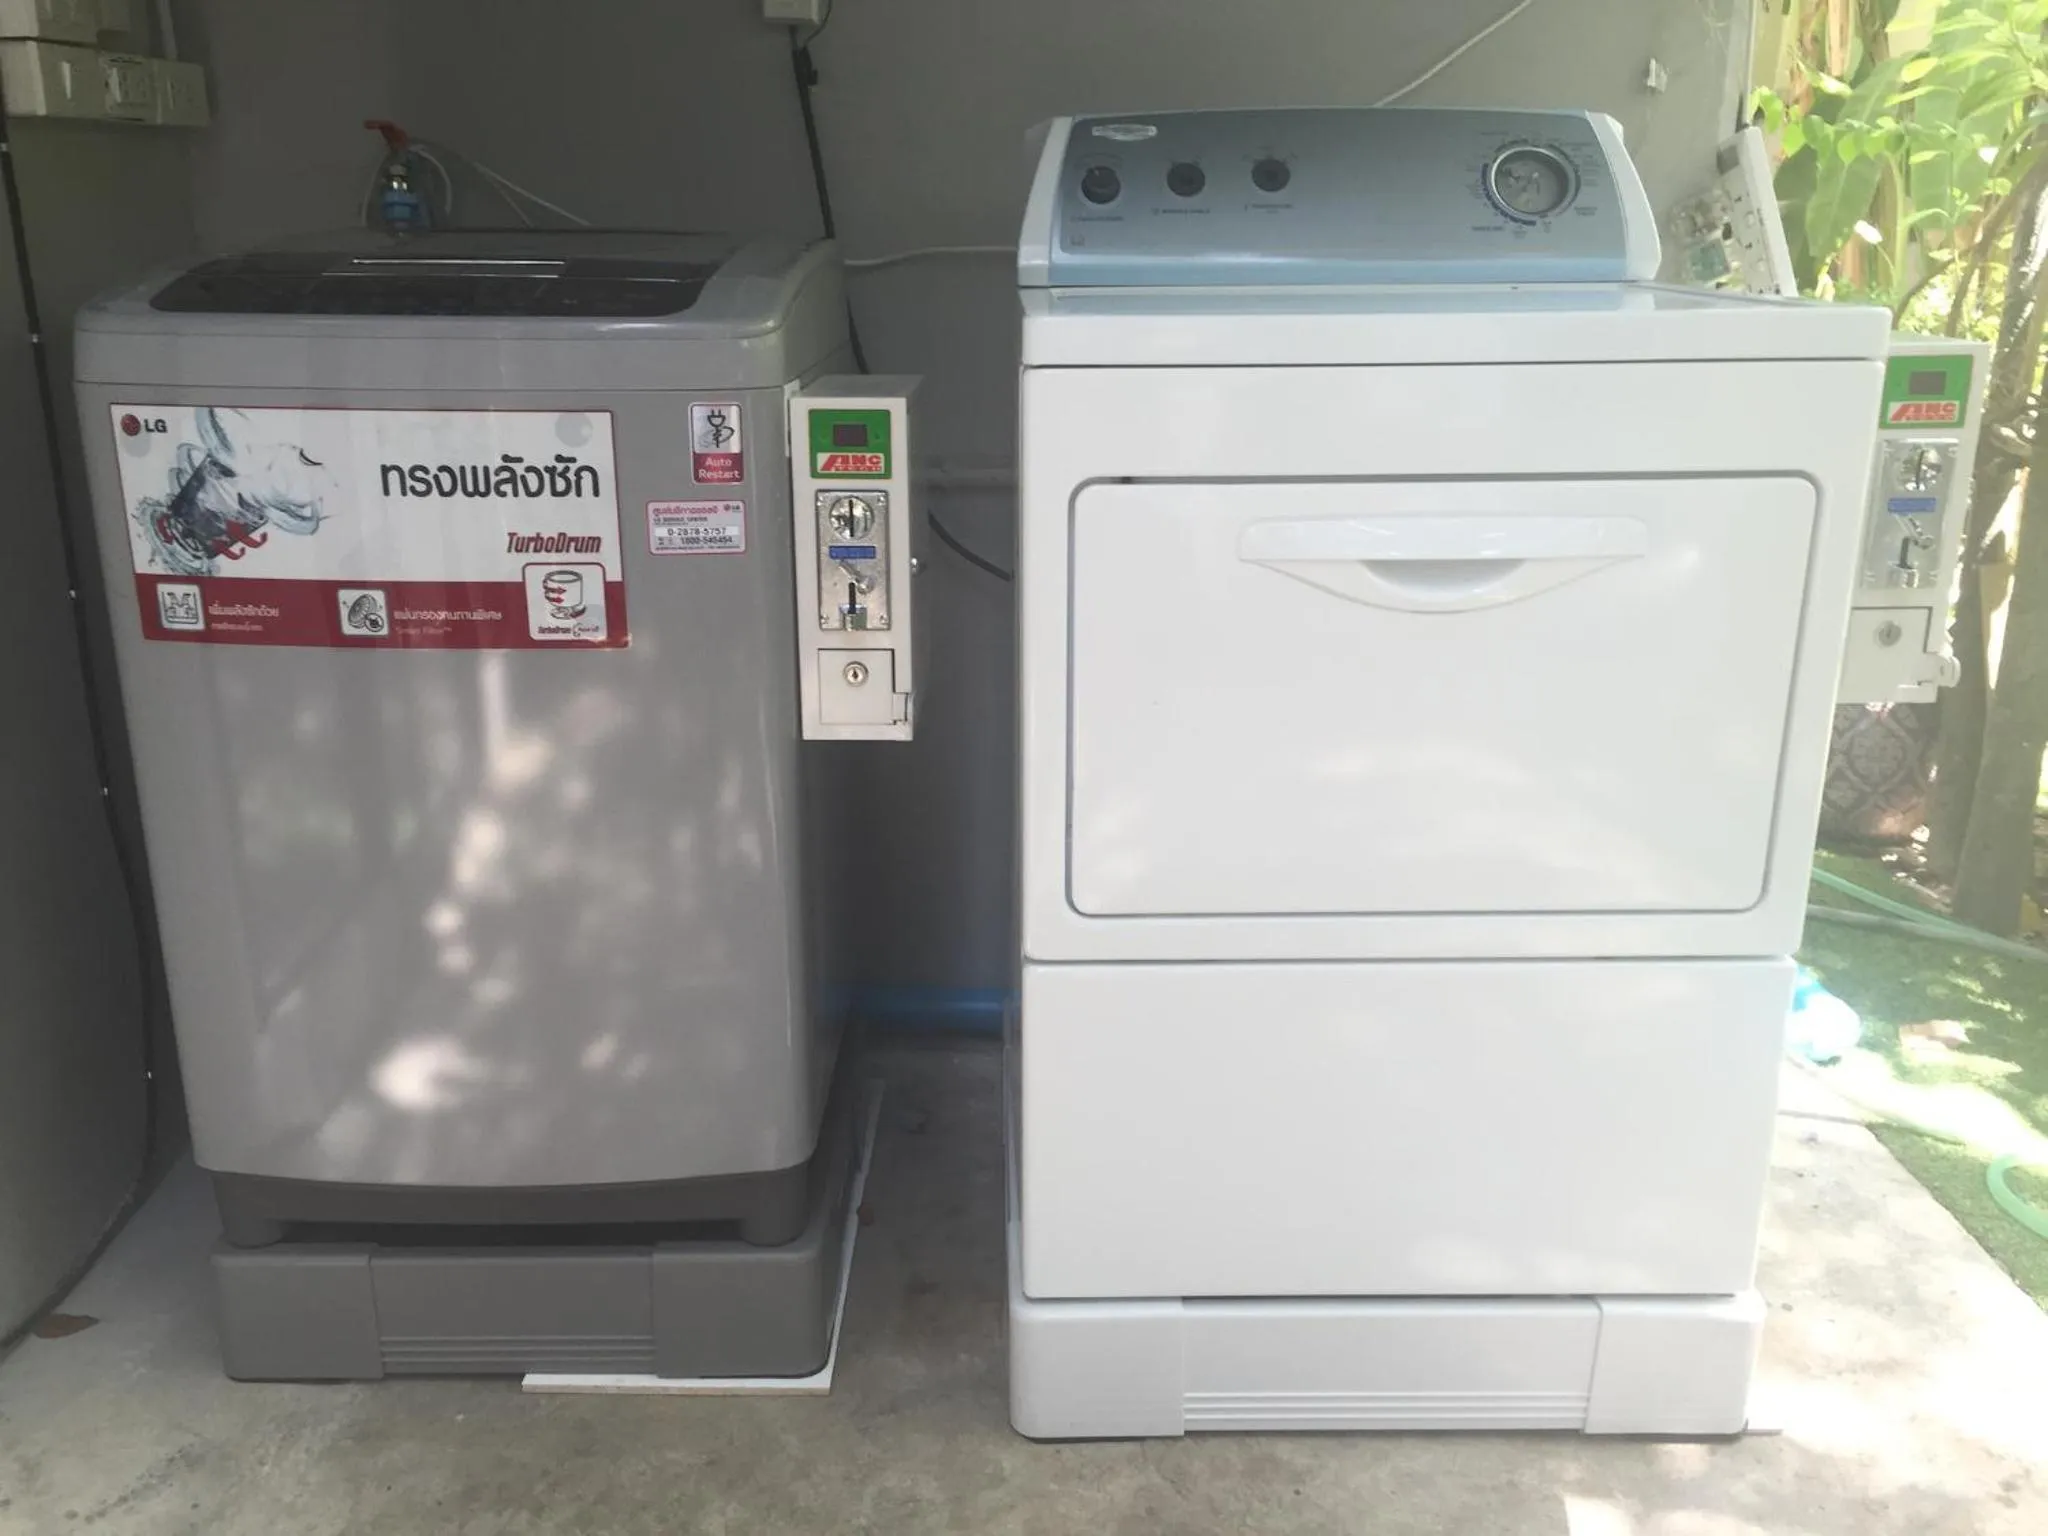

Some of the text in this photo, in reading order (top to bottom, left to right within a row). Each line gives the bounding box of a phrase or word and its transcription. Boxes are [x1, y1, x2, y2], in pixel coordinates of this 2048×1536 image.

[143, 418, 168, 433] LG
[705, 457, 732, 467] Auto
[380, 453, 600, 498] ทรงพลังซัก
[698, 469, 741, 479] Restart
[507, 532, 602, 553] TurboDrum
